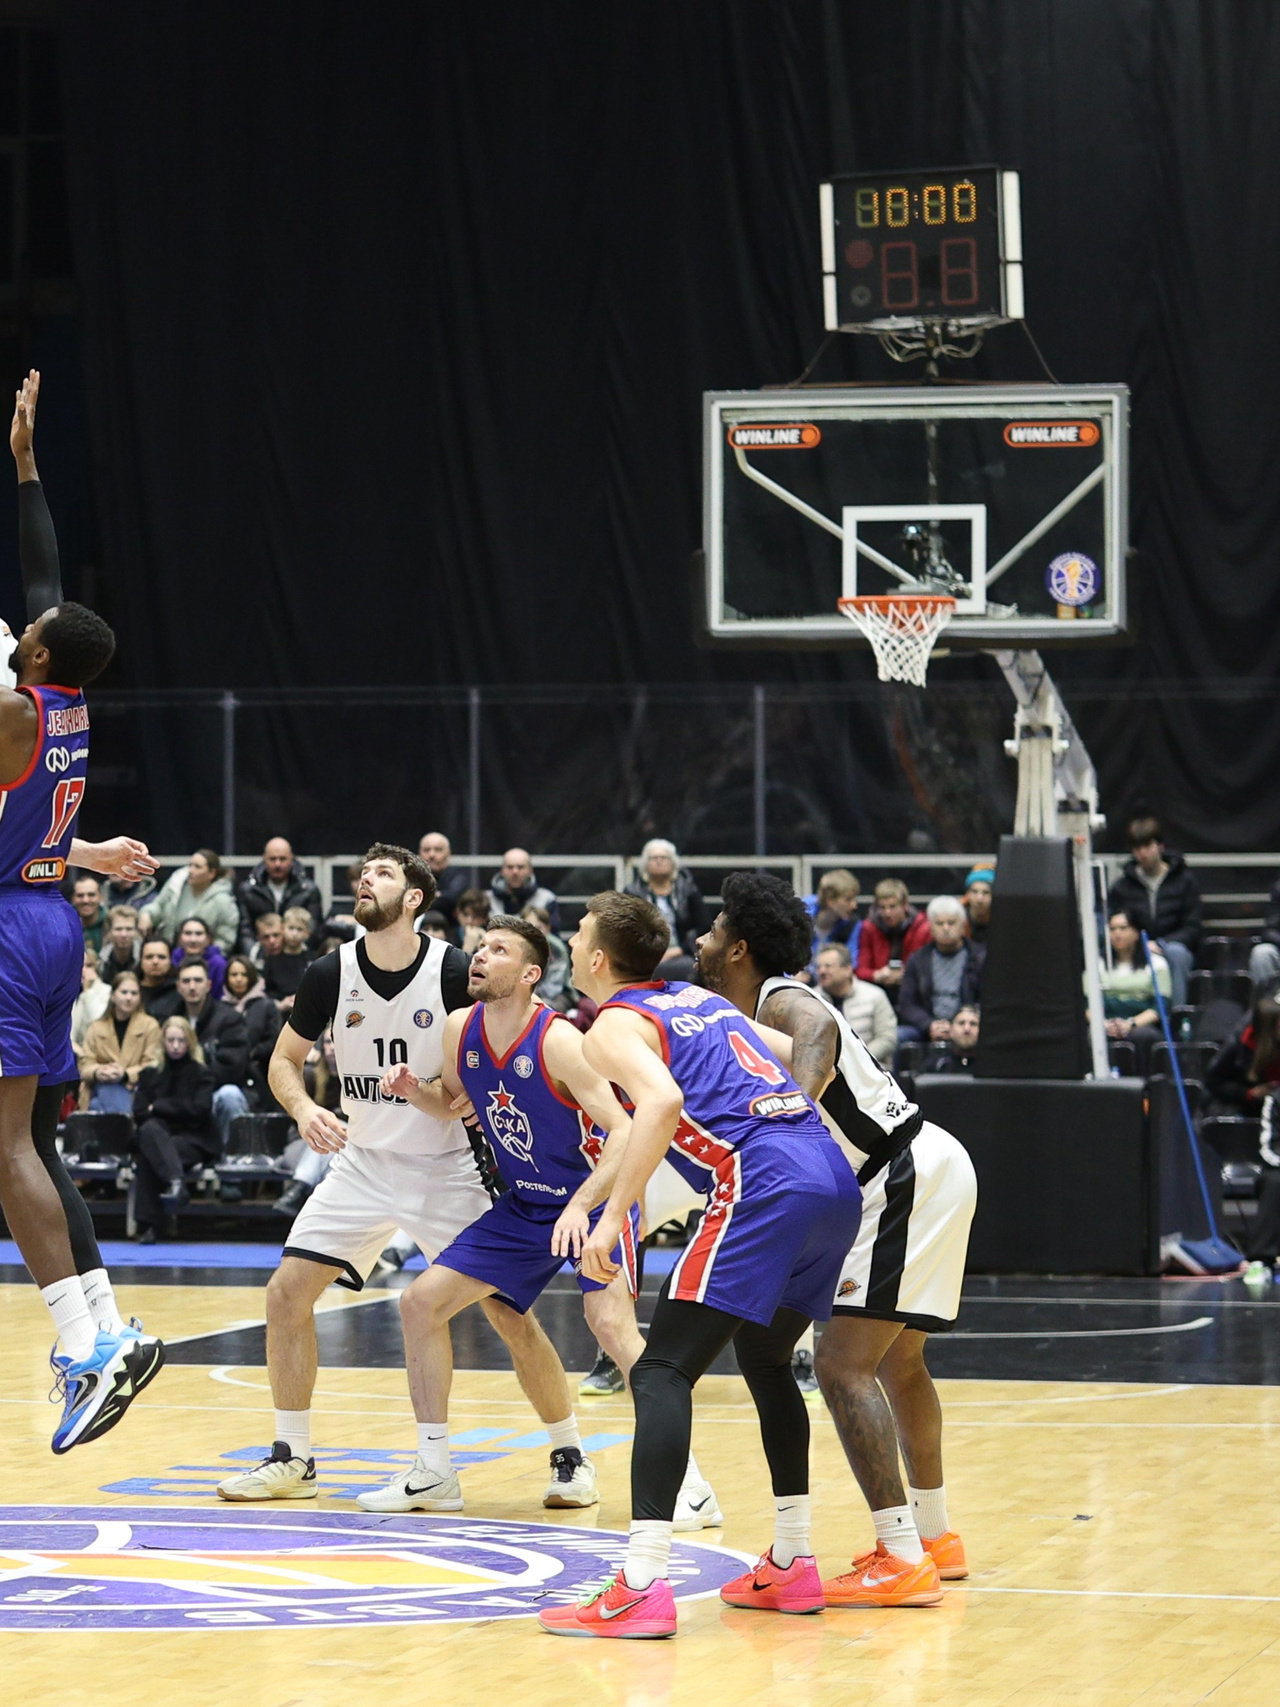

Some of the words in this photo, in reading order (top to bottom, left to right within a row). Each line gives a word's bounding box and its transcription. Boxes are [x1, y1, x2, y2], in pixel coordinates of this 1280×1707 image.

[871, 183, 977, 228] 10:00
[734, 429, 802, 446] WINLINE
[1010, 426, 1079, 443] WINLINE
[41, 776, 87, 849] 17
[372, 1037, 408, 1067] 10
[727, 1030, 787, 1086] 4
